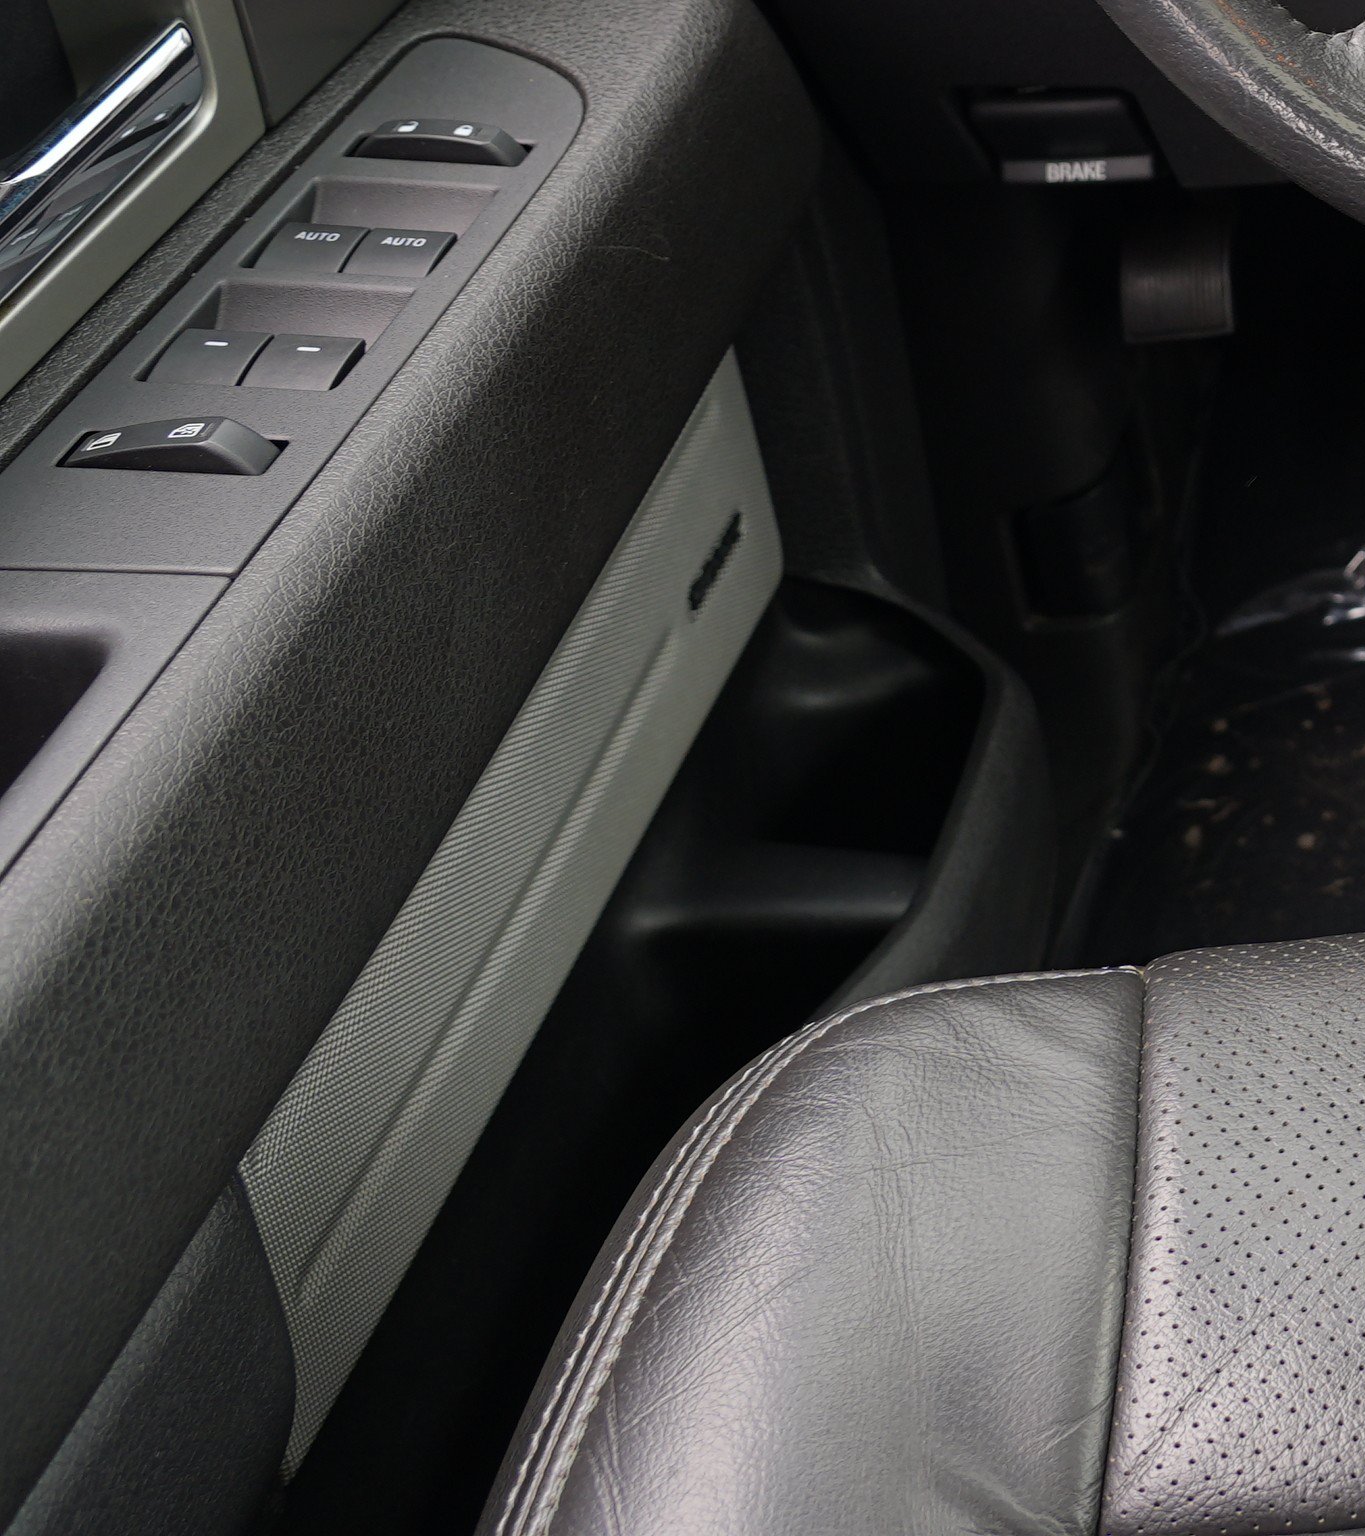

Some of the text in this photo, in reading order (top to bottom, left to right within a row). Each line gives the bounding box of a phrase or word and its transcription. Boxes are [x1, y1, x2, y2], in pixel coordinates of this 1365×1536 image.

[1045, 160, 1107, 183] BRAKE
[294, 231, 341, 242] AUTO
[380, 236, 427, 247] AUTO
